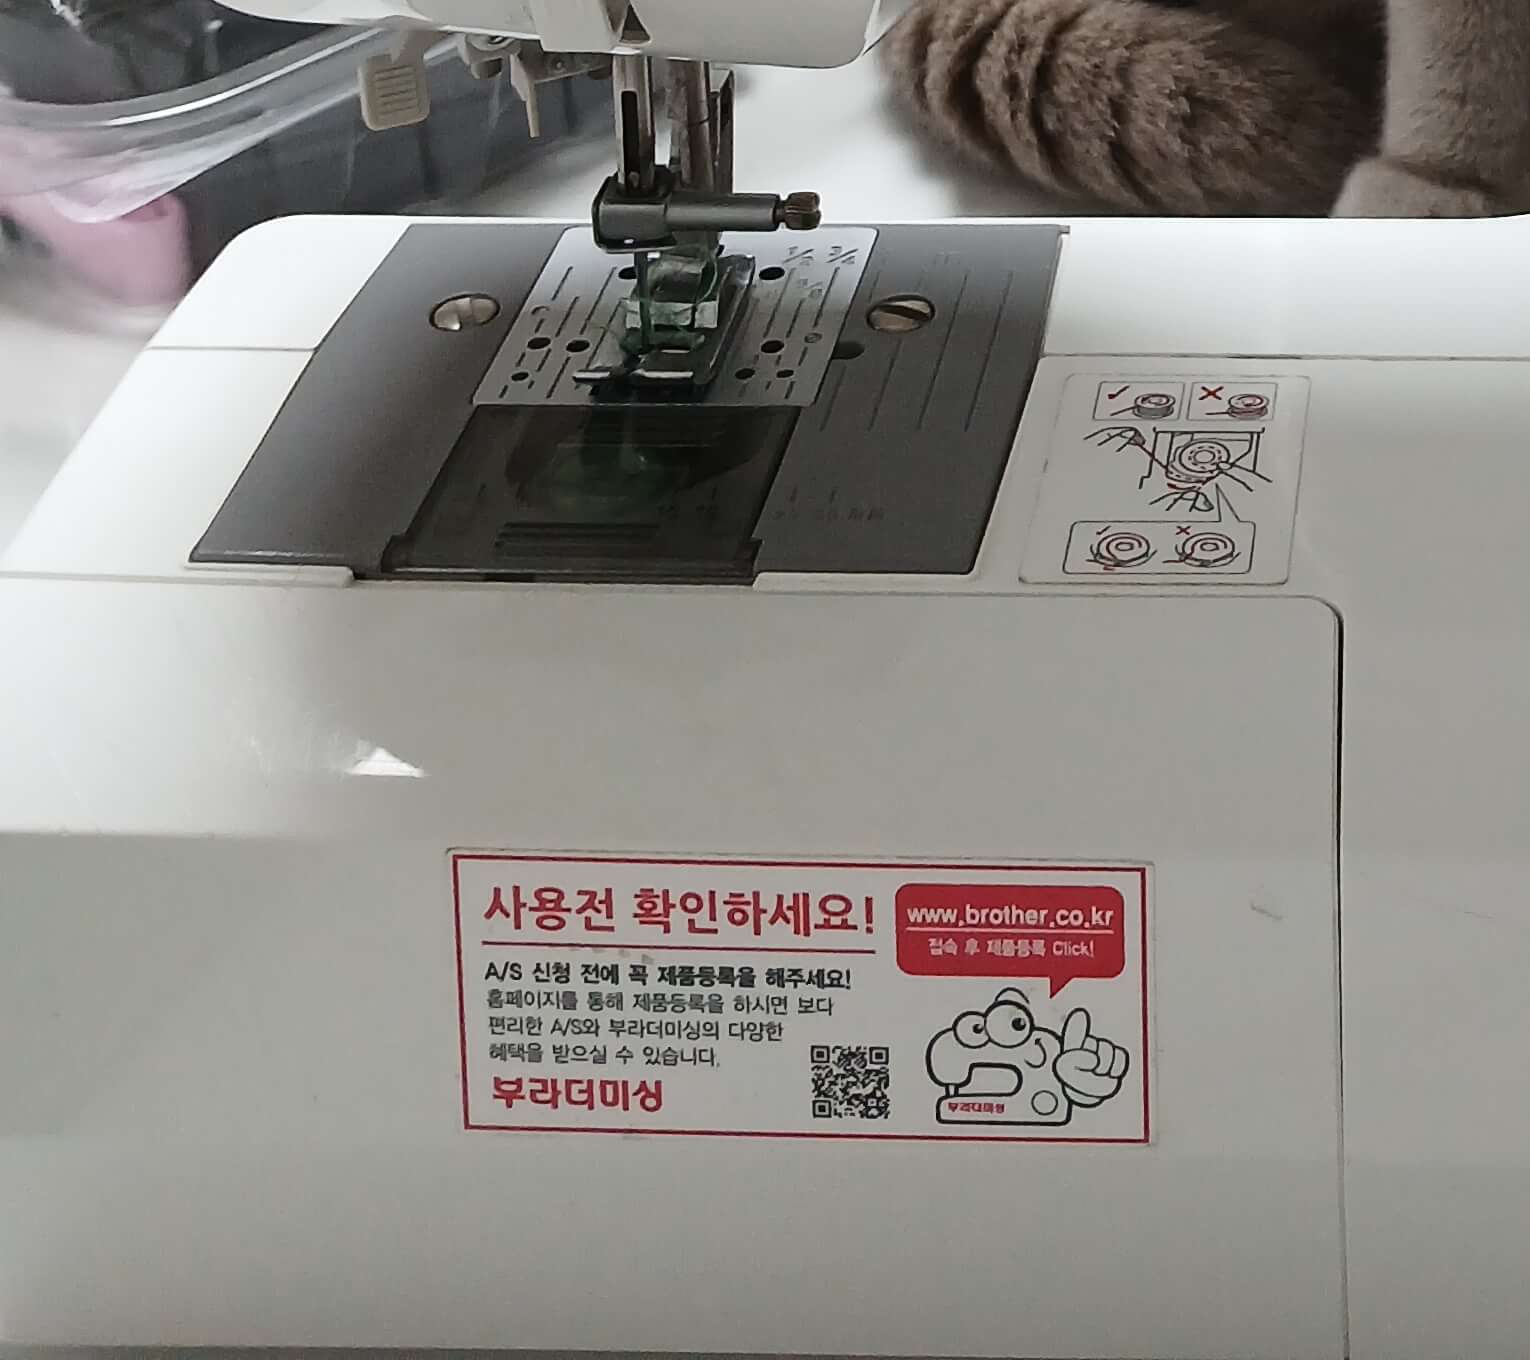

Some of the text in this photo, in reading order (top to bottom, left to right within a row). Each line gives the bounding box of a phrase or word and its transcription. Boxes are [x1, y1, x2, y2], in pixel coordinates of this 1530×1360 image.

[483, 885, 874, 936] 사용전 확인하세요!
[907, 904, 1113, 928] www.brother.co.kr
[1052, 939, 1094, 957] Click!
[485, 961, 522, 980] A/S
[533, 962, 570, 984] 신청
[581, 964, 619, 985] 전에
[658, 965, 756, 988] 제품등록을
[765, 968, 850, 989] 해주세요!
[487, 989, 578, 1010] 홈페이지를
[633, 992, 724, 1014] 제품등록을
[733, 994, 787, 1015] 하시면
[798, 996, 833, 1016] 보다
[489, 1016, 784, 1041] 편리한 A/S와 부라더미싱의 다양한
[552, 1044, 607, 1064] 받으실
[616, 1045, 633, 1064] 수
[492, 1076, 663, 1112] 부라더미싱
